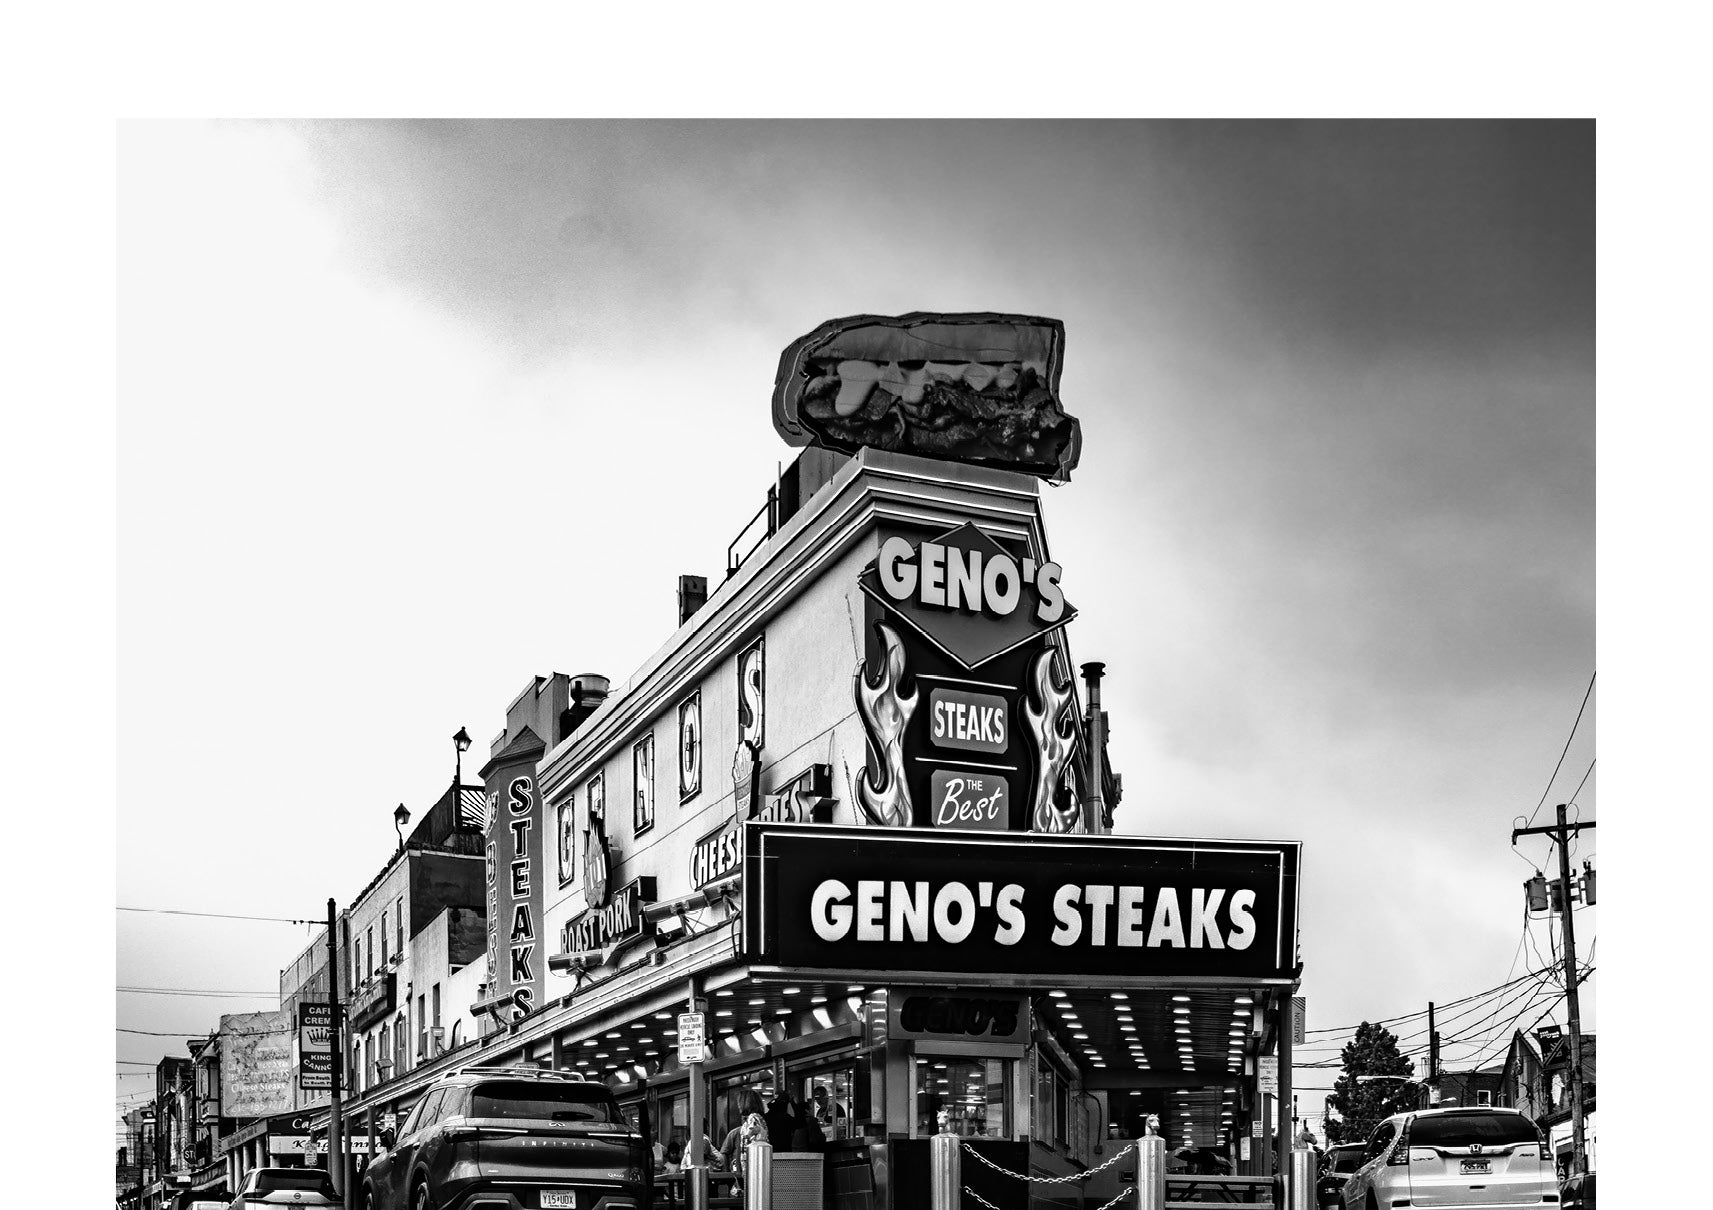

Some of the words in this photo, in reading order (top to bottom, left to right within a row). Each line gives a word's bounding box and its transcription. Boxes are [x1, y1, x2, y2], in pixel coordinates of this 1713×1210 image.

[878, 536, 1065, 623] GENO'S
[934, 700, 1005, 744] STEAKS
[937, 778, 1004, 825] Best
[967, 779, 983, 791] THE
[508, 776, 535, 1021] STEAKS
[561, 915, 595, 954] ROAST
[599, 888, 632, 942] PORK
[810, 878, 1026, 946] GENO'S
[1051, 883, 1256, 950] STEAKS
